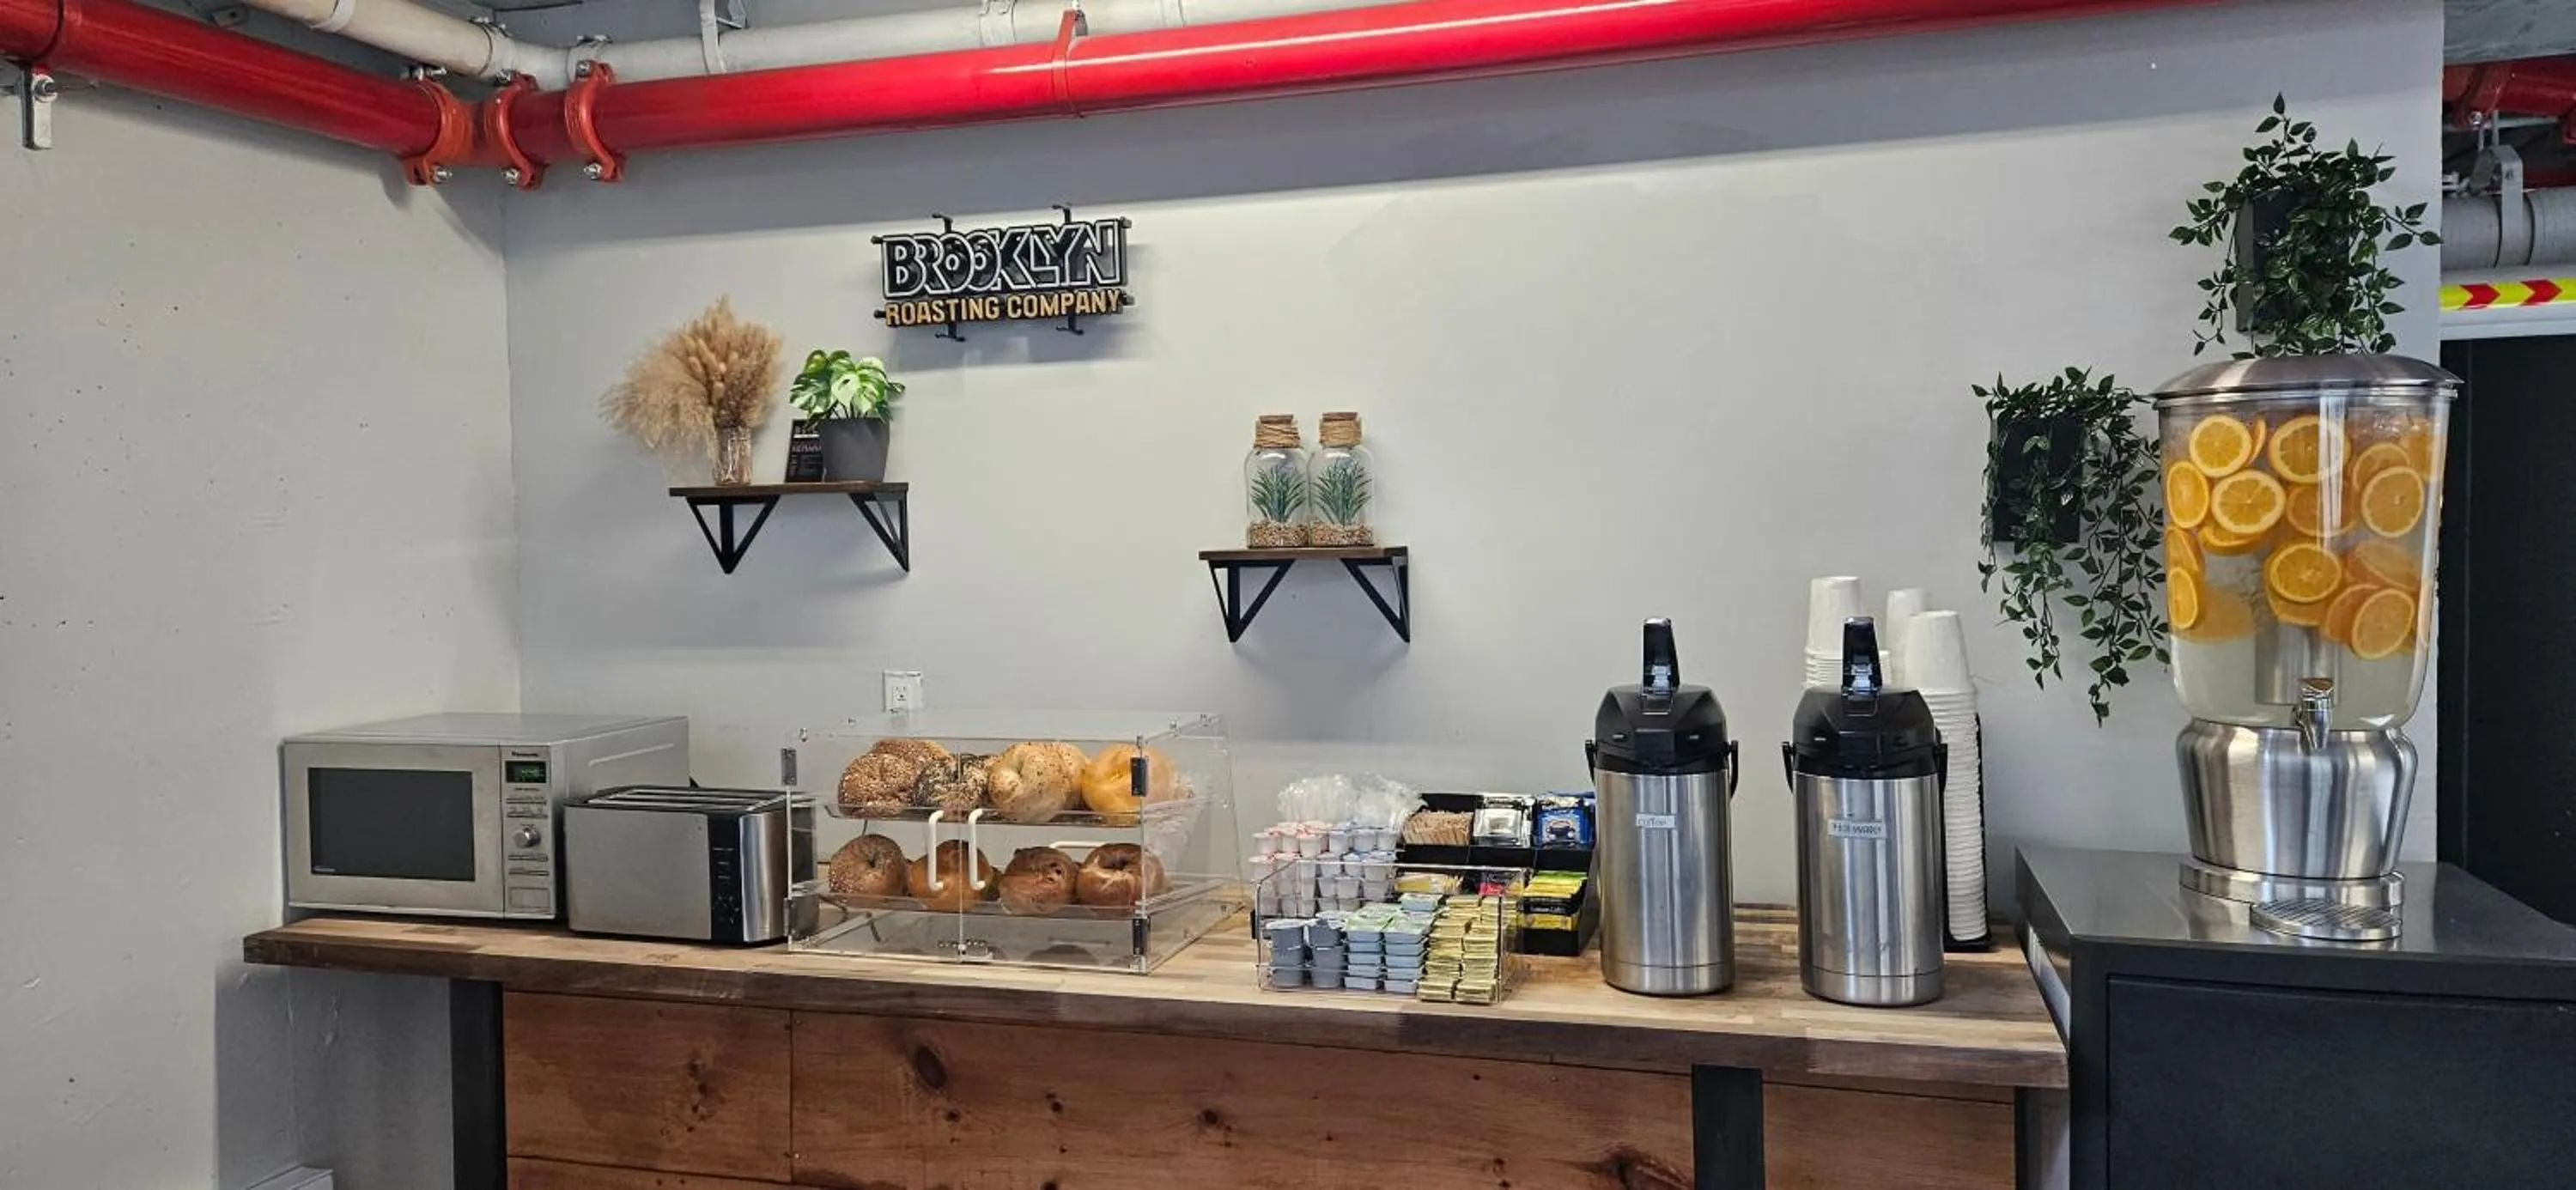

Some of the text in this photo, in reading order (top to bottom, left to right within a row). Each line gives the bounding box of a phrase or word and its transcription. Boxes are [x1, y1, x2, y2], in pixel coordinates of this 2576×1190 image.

[882, 218, 1121, 299] BROOKLYN
[885, 289, 1121, 326] ROASTING COMPANY
